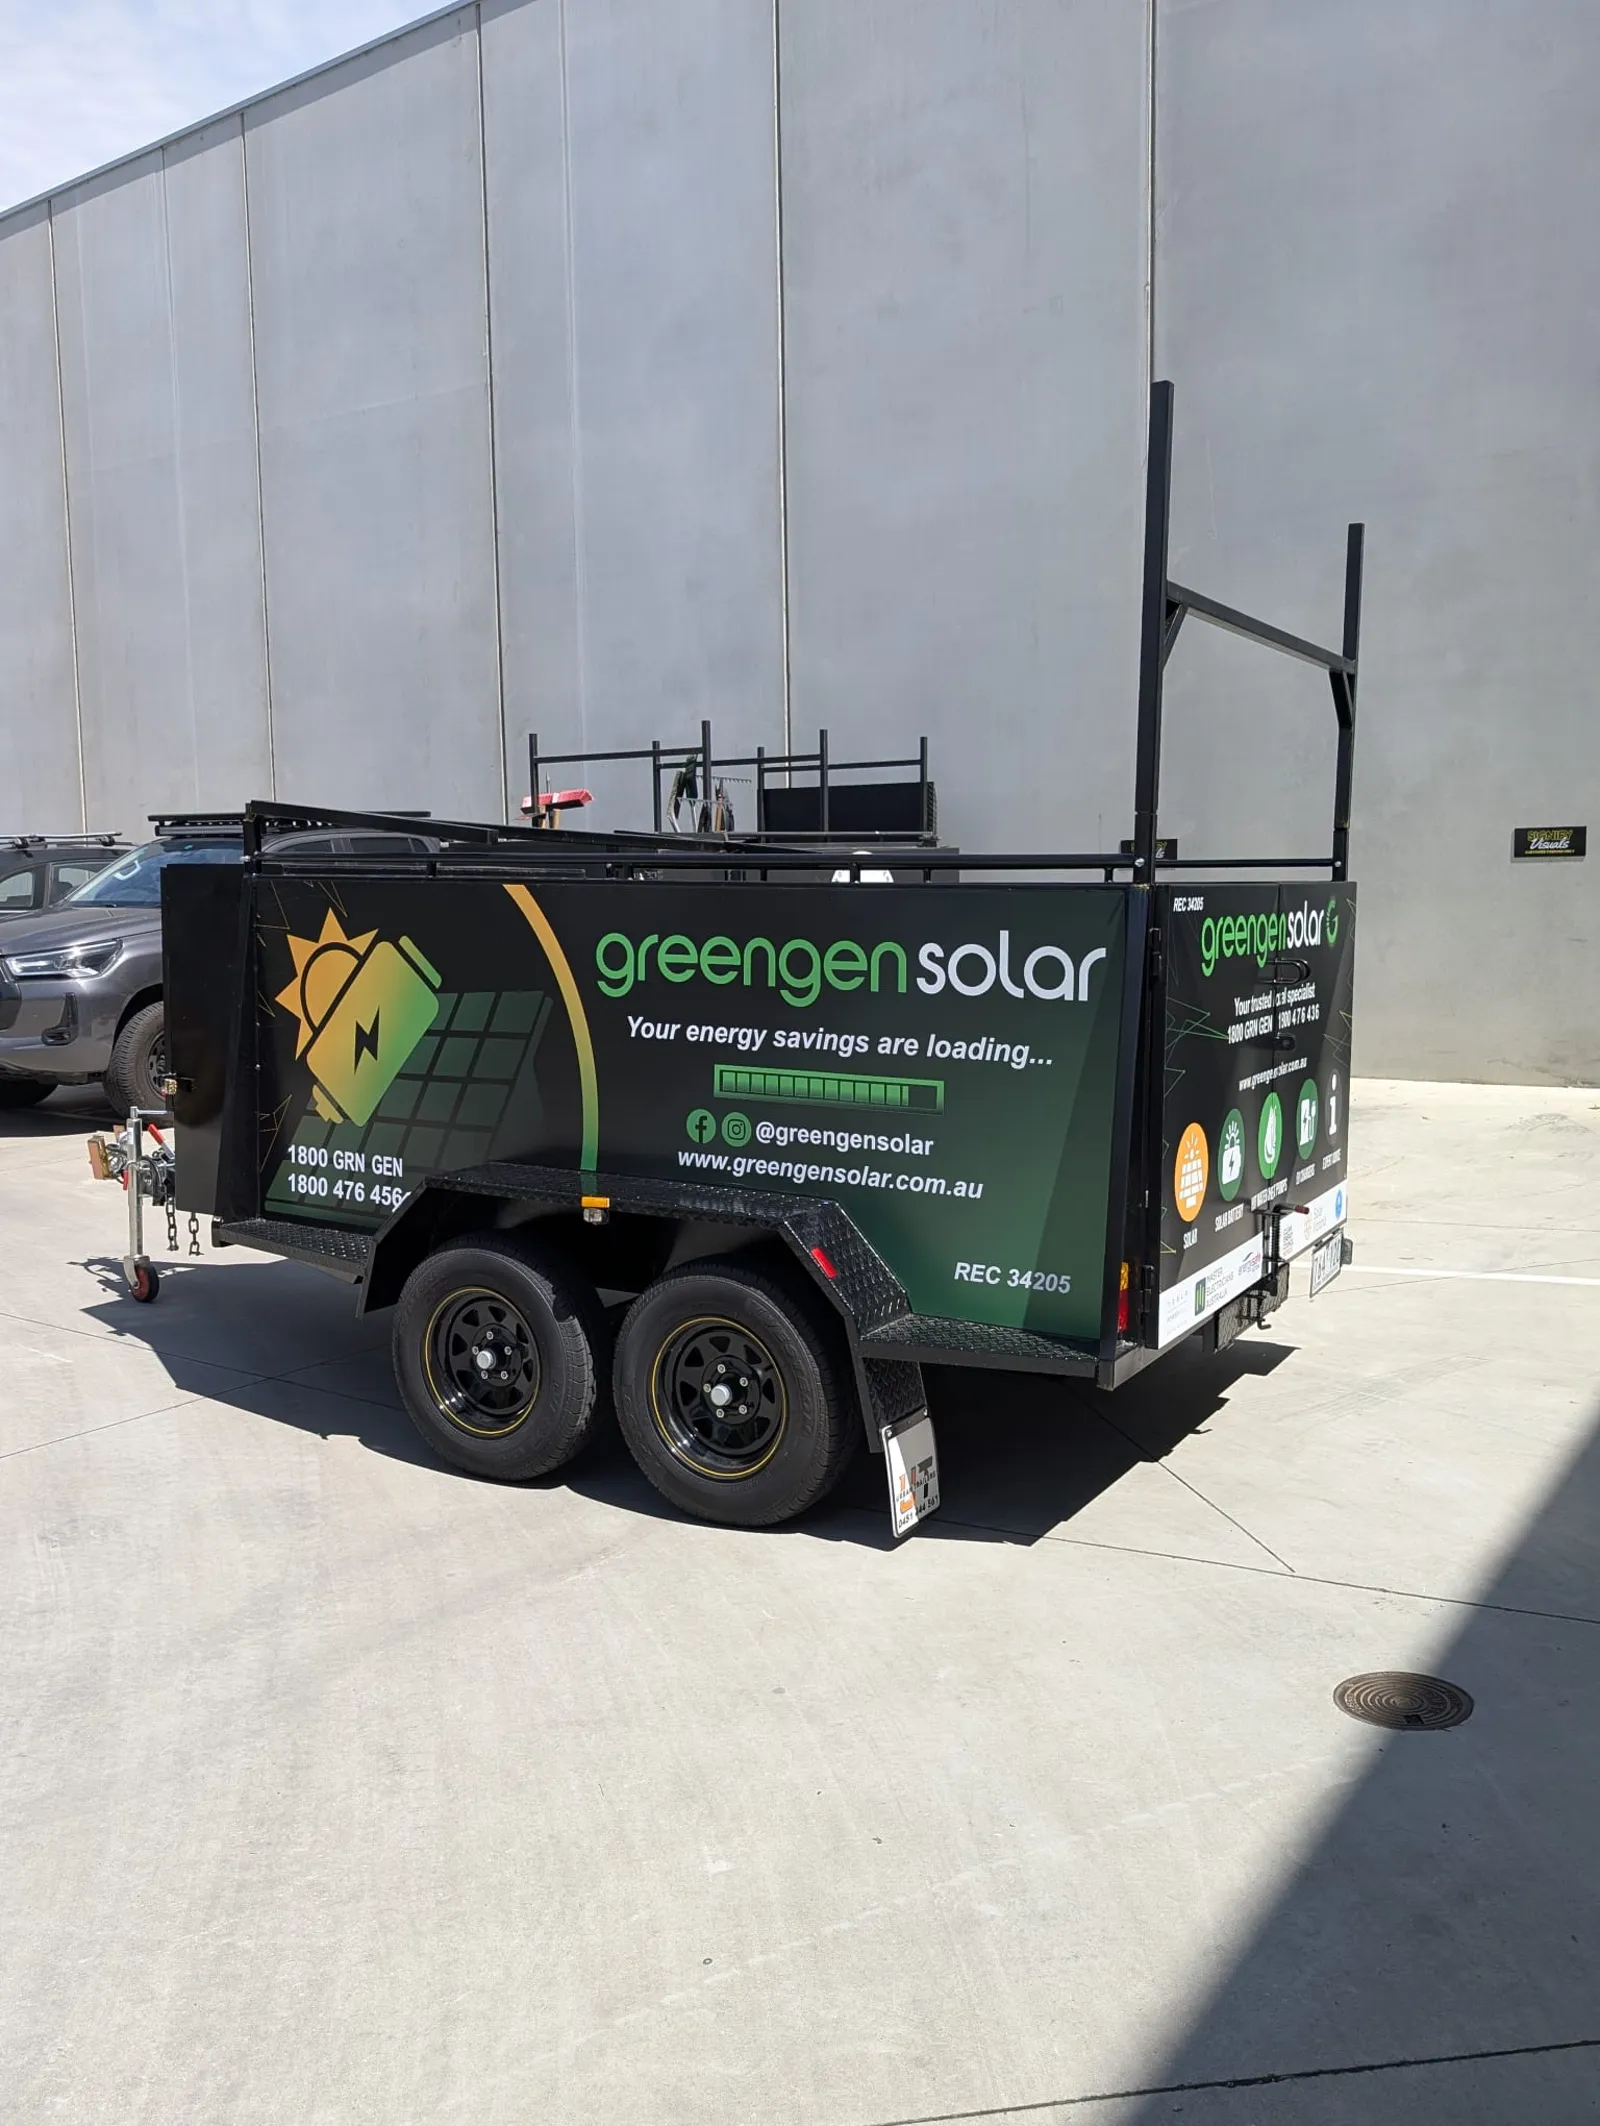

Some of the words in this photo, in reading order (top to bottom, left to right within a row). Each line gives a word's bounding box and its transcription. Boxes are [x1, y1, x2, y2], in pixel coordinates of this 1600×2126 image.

[1530, 837, 1570, 849] Visuals
[1173, 898, 1188, 912] REC
[1201, 912, 1286, 977] greengen
[1287, 900, 1325, 949] solar
[596, 932, 907, 1007] greengen
[916, 930, 1107, 1001] solar
[1234, 997, 1250, 1016] Your
[1251, 990, 1272, 1012] trusted
[1287, 982, 1316, 1007] specialist
[1228, 1023, 1243, 1044] 1800
[1244, 1018, 1258, 1040] GRN
[1258, 1014, 1273, 1035] GEN
[1291, 1006, 1306, 1026] 476
[1306, 1003, 1320, 1022] 436
[627, 1016, 680, 1040] Your
[686, 1021, 767, 1051] energy
[773, 1029, 869, 1056] savings
[877, 1036, 919, 1056] are
[926, 1034, 1054, 1069] loading...
[755, 1121, 934, 1156] @greengensolar
[288, 1144, 328, 1168] 1800
[333, 1150, 365, 1173] GRN
[372, 1154, 403, 1177] GEN
[678, 1150, 983, 1200] www.greengensolar.com.au
[288, 1173, 328, 1197] 1800
[333, 1179, 365, 1202] 476
[369, 1184, 403, 1207] 456
[1215, 1210, 1228, 1232] SOLAR
[1183, 1228, 1198, 1250] SOLAR
[954, 1262, 1001, 1285] REC
[1007, 1268, 1071, 1294] 34205
